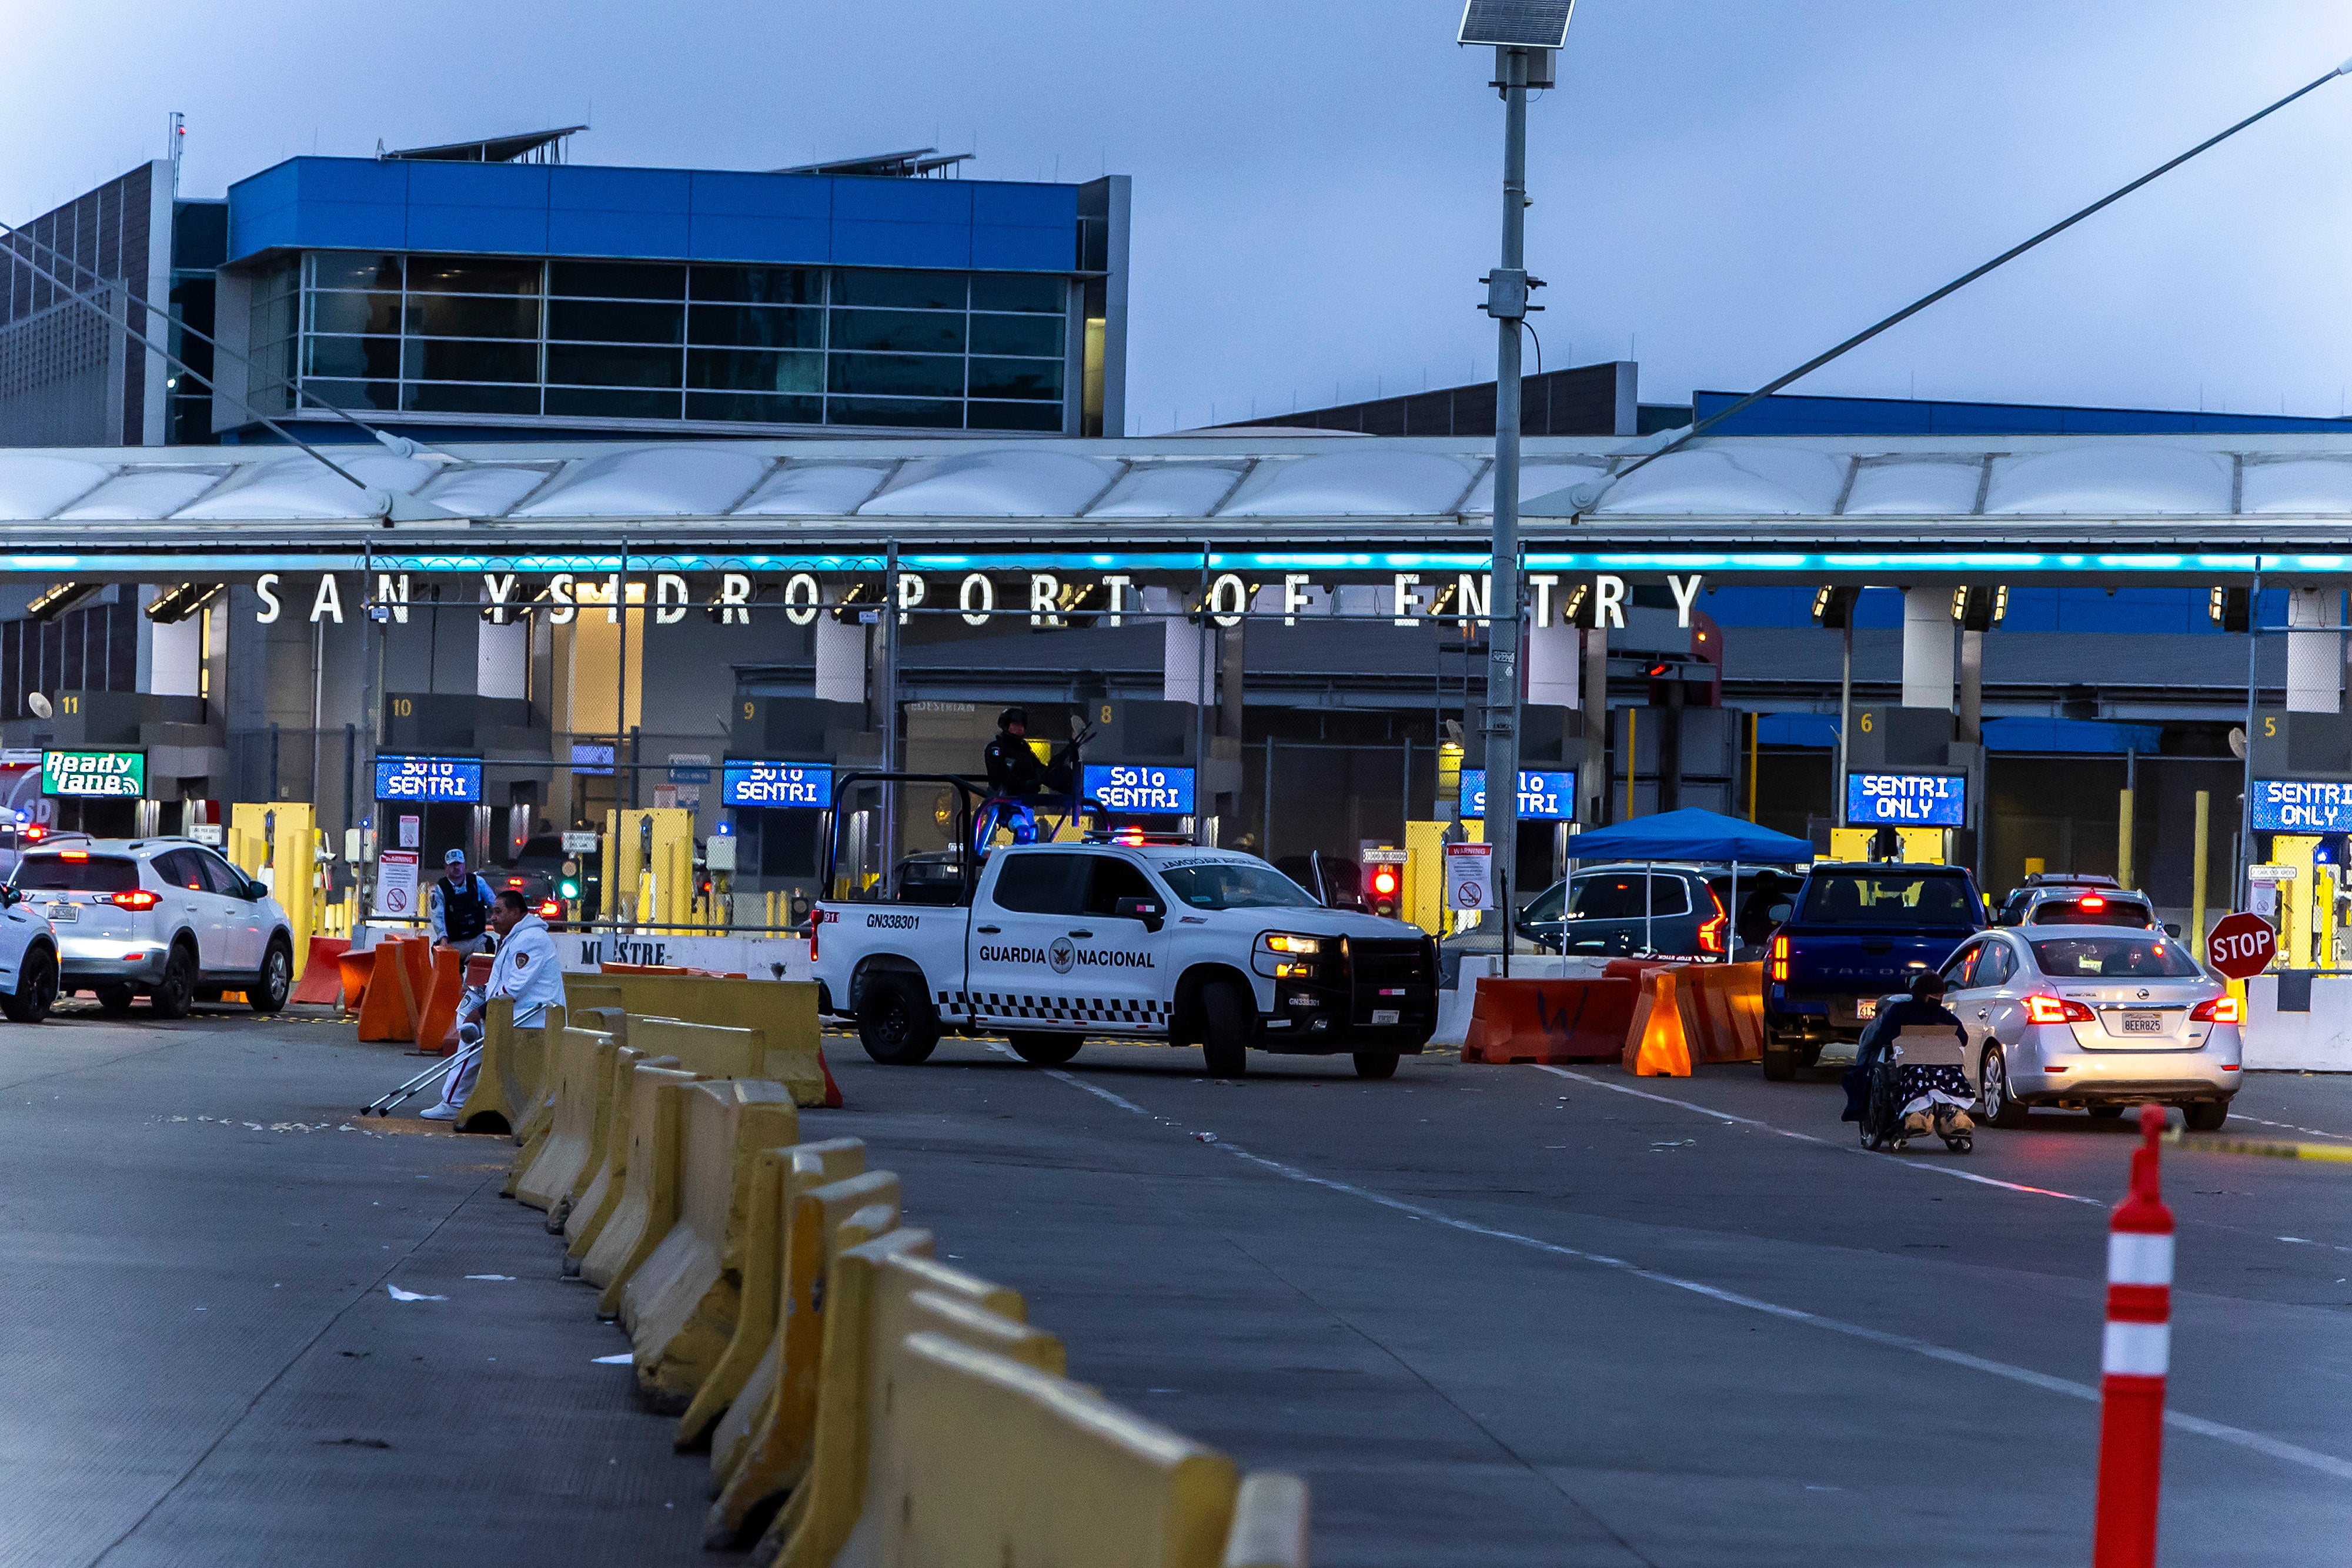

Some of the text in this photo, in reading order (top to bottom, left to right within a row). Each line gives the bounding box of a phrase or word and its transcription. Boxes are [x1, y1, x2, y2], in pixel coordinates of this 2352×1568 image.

[256, 573, 1702, 628] SAN YSIDRO PORT OF ENTRY
[62, 697, 78, 714] 11
[393, 698, 411, 717] 10
[743, 701, 755, 720] 9
[1101, 706, 1112, 724] 8
[1861, 713, 1873, 733] 6
[2264, 717, 2276, 737] 5
[46, 752, 132, 781] Ready
[57, 772, 123, 794] Lane
[388, 775, 467, 796] SENTRI
[1111, 767, 1165, 787] Solo
[1519, 772, 1545, 792] lo
[1862, 775, 1949, 798] SENTRI
[736, 781, 817, 802] SENTRI
[1097, 787, 1179, 808] SENTRI
[2267, 783, 2352, 804] SENTRI
[1474, 791, 1558, 814] STRI
[1876, 798, 1933, 818] ONLY
[2281, 804, 2338, 826] ONLY
[824, 913, 839, 922] 911
[867, 914, 920, 930] GN338301
[2213, 930, 2270, 962] STOP
[980, 946, 1155, 968] GUARDIA NACIONAL
[2125, 1021, 2160, 1031] 8EER825
